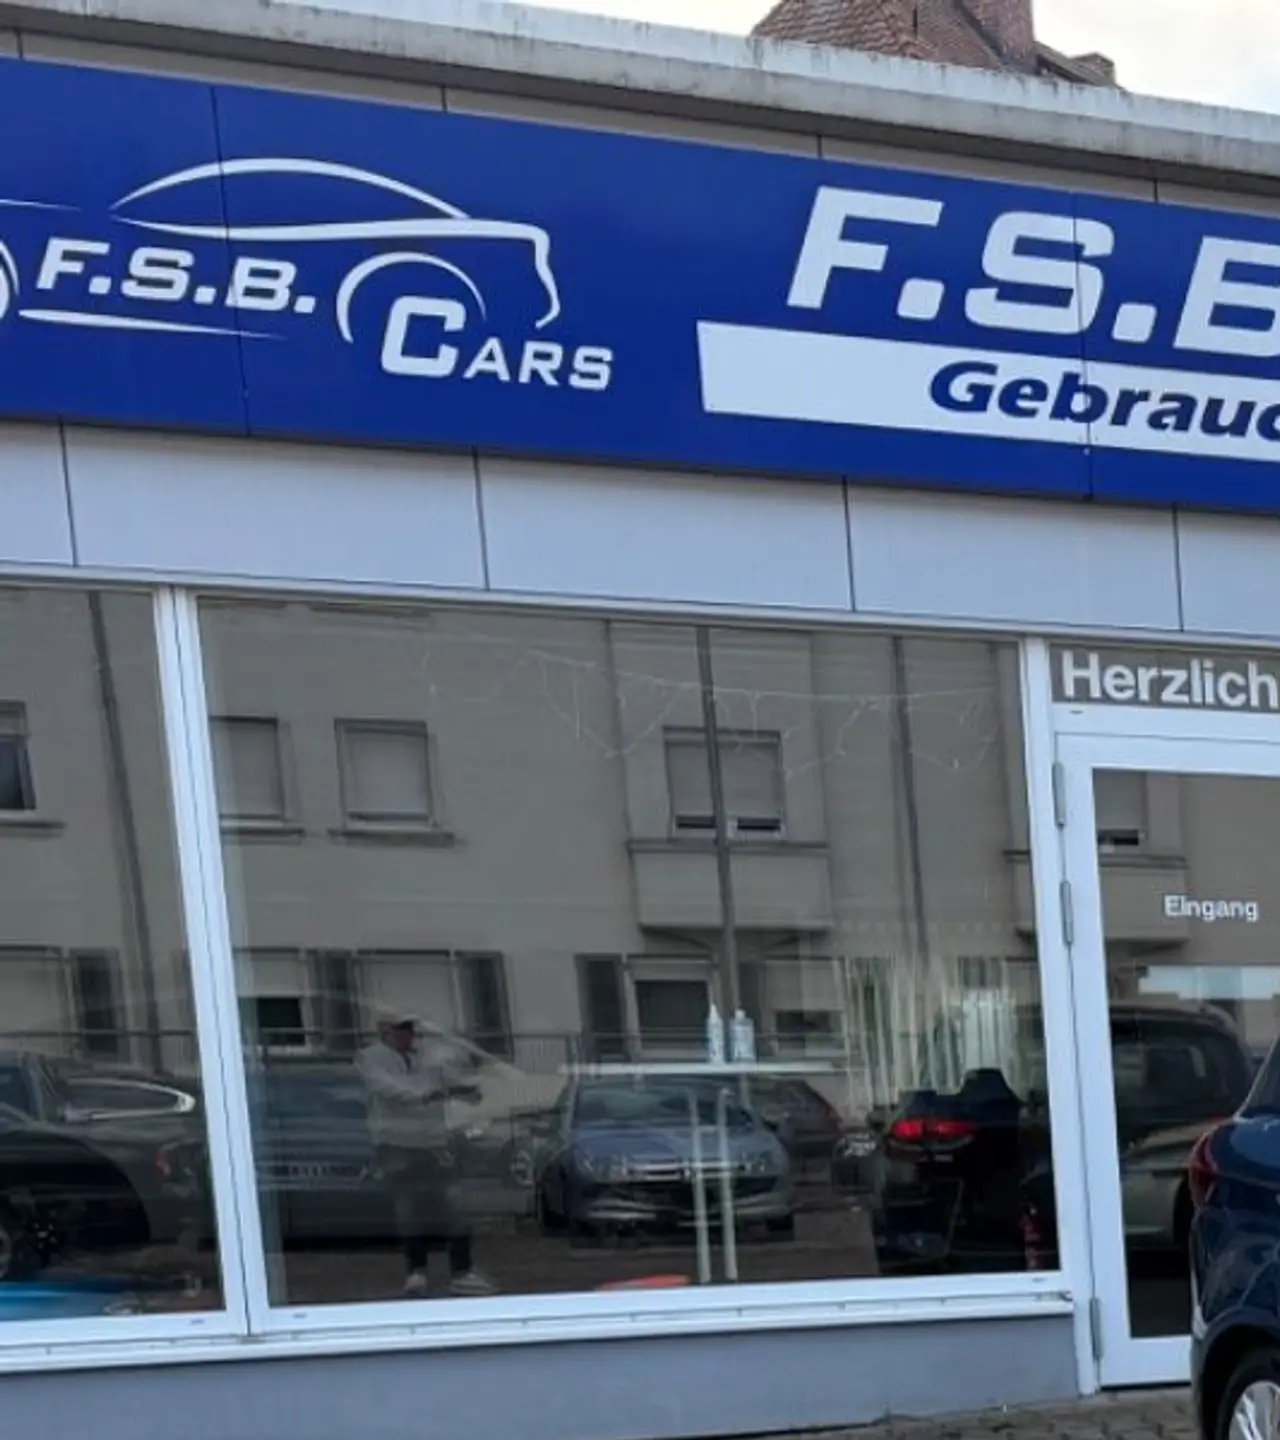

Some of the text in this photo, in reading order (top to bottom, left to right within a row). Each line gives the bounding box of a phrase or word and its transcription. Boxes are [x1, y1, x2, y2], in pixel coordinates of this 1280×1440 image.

[36, 237, 318, 315] F.S.B.
[1061, 650, 1279, 710] Herzlich
[1163, 894, 1258, 923] Eingang
